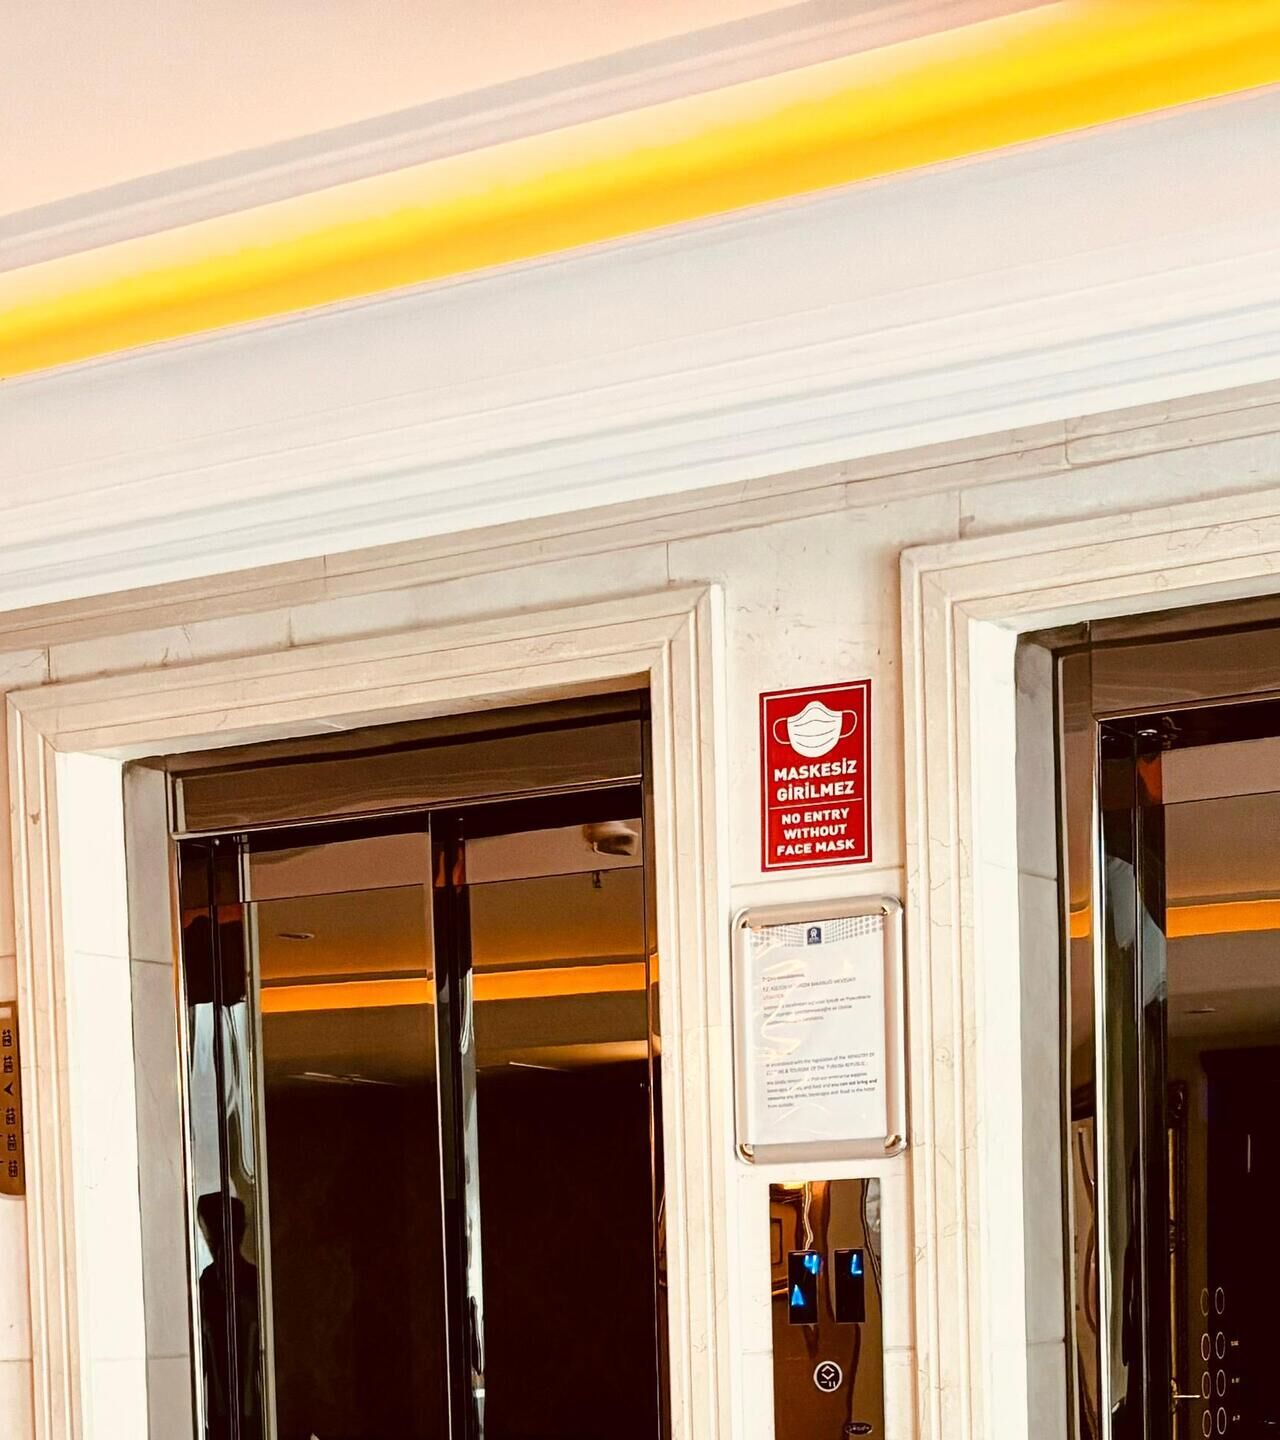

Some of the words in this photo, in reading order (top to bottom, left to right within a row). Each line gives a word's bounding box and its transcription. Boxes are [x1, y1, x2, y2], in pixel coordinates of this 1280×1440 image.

[774, 758, 857, 782] MASKESİZ
[777, 781, 855, 802] GİRİLMEZ
[781, 813, 800, 825] NO
[804, 807, 849, 823] ENTRY
[784, 823, 848, 840] WITHOUT
[777, 842, 812, 857] FACE
[815, 838, 855, 853] MASK
